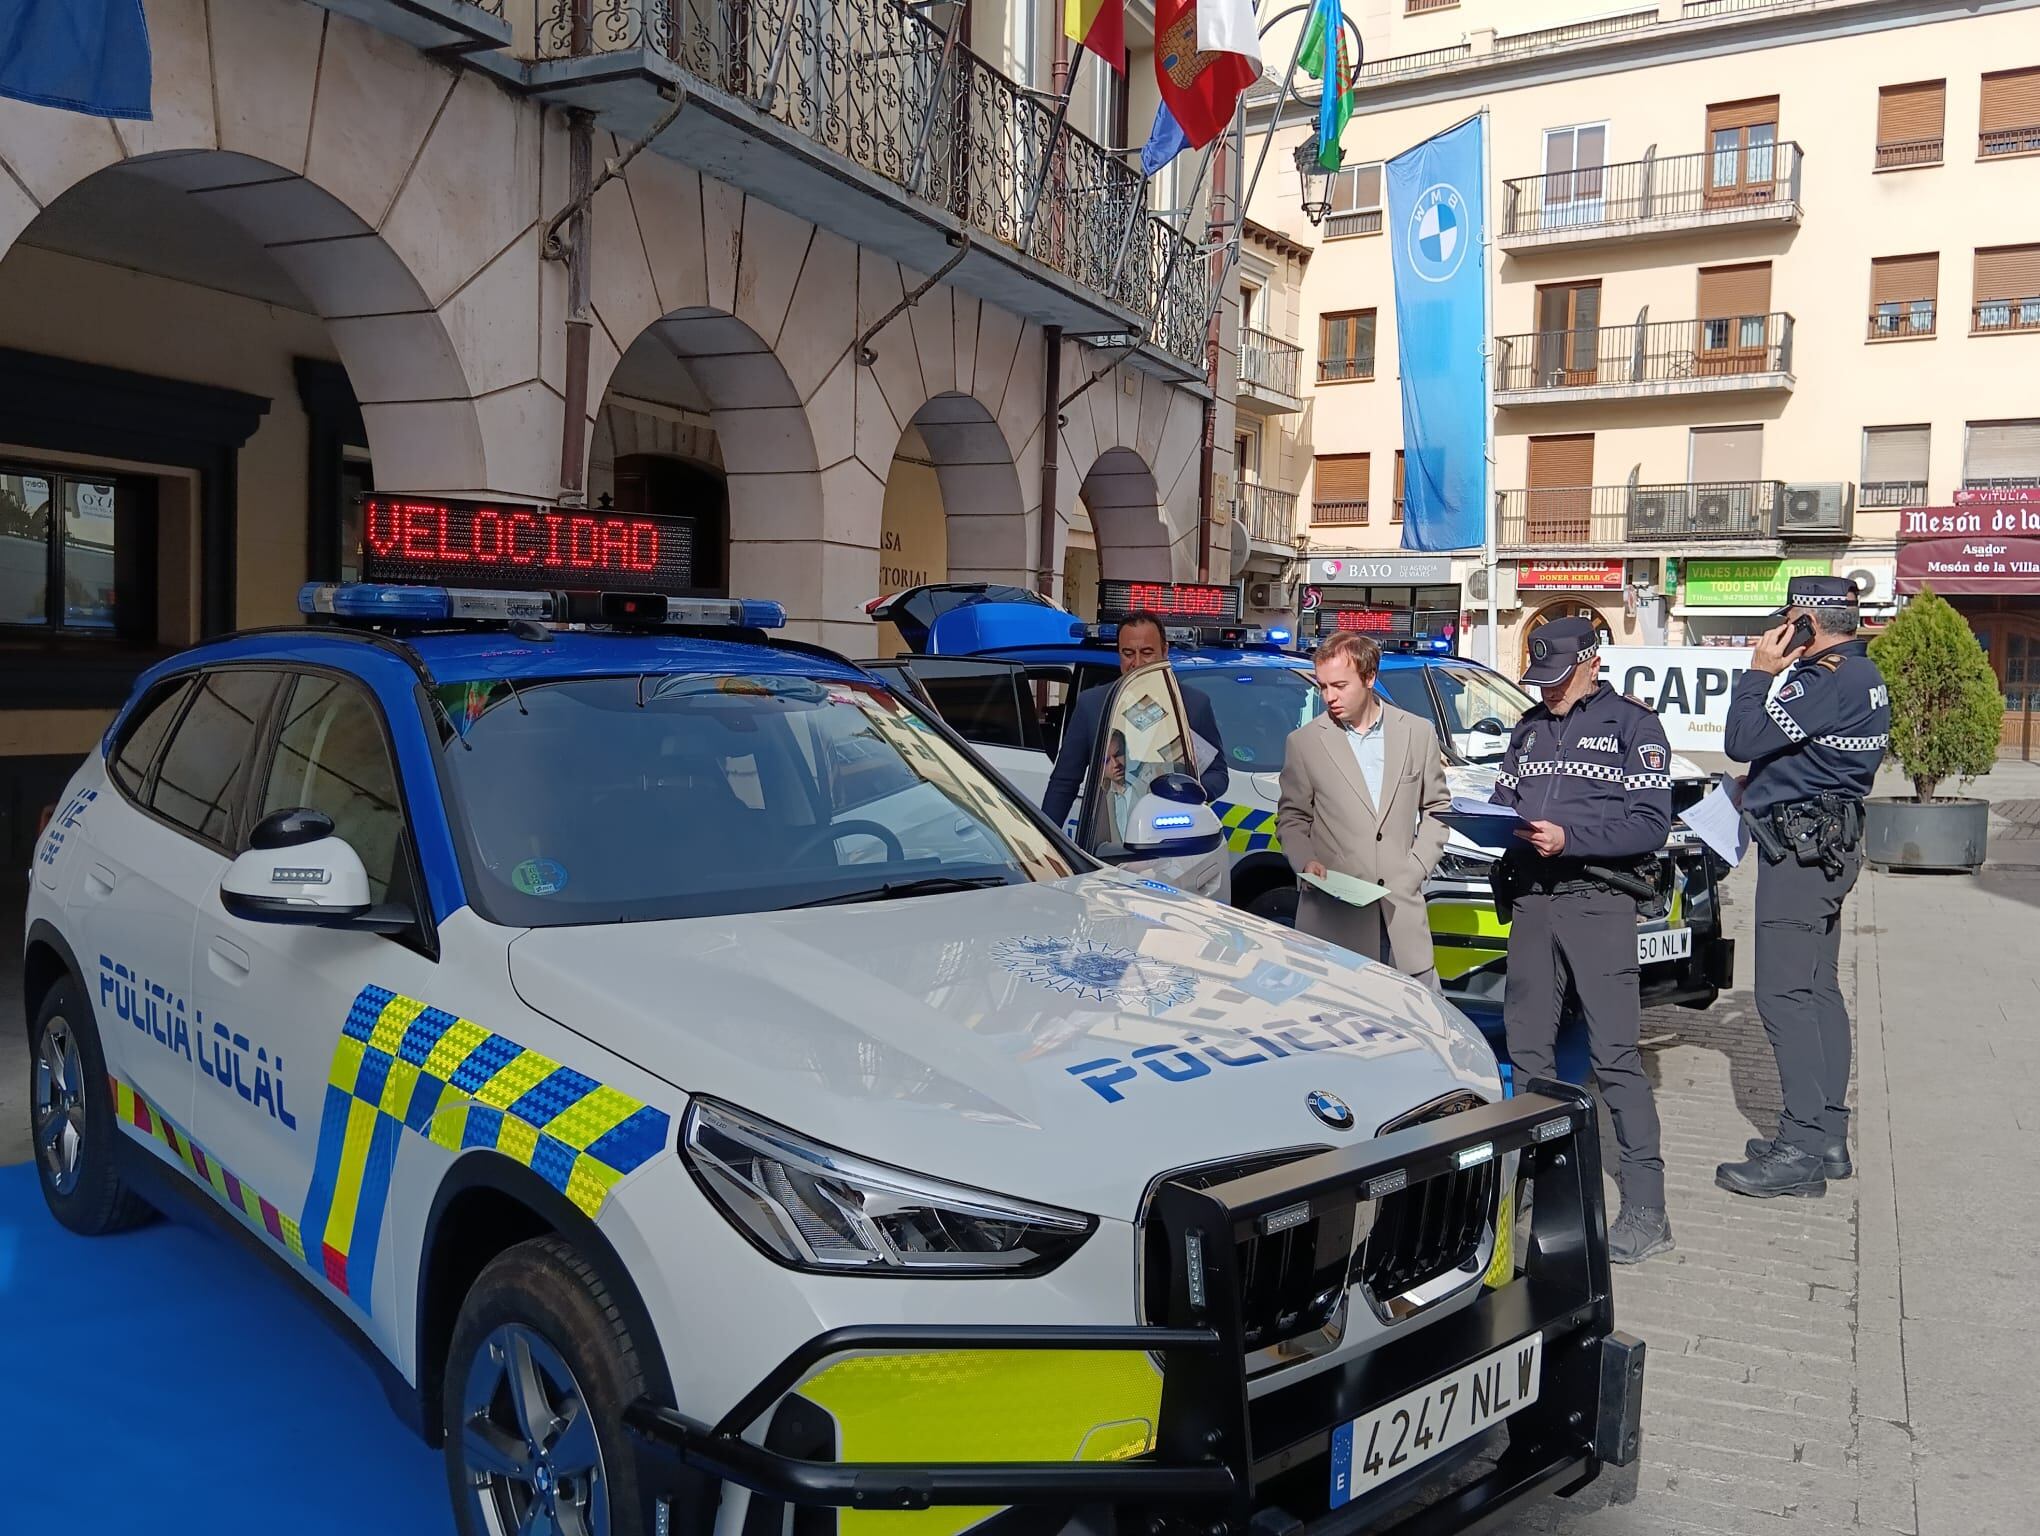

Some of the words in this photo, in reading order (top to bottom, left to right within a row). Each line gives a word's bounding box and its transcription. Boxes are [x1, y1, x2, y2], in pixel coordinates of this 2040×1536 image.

[1980, 492, 2029, 501] VITULIA
[1905, 511, 1981, 533] Mesón
[1992, 509, 2016, 531] de
[2021, 508, 2040, 530] la
[369, 502, 660, 571] VELOCIDAD
[1962, 544, 2007, 555] Asador
[1349, 565, 1392, 577] BAYO
[1532, 561, 1609, 572] ISTANBUL
[1692, 567, 1731, 578] VIAJES
[1735, 567, 1780, 577] ARANDA
[1786, 566, 1825, 577] TOURS
[1928, 561, 1970, 573] Mesón
[1974, 561, 1990, 573] de
[1993, 562, 2006, 573] la
[2010, 562, 2040, 573] Villa
[1712, 582, 1741, 592] TODO
[1744, 582, 1759, 592] EN
[1130, 584, 1223, 615] PELIGRO
[1337, 611, 1393, 632] SIGAME
[1623, 666, 1752, 715] CAPI
[1688, 721, 1725, 733] Autho
[1577, 734, 1620, 754] POLICÍA
[1639, 937, 1657, 960] 50
[1662, 932, 1688, 957] NLW
[196, 1010, 297, 1132] LOCAL
[1362, 1382, 1459, 1477] 4247
[1471, 1345, 1535, 1426] NLW
[1337, 1472, 1345, 1490] E
